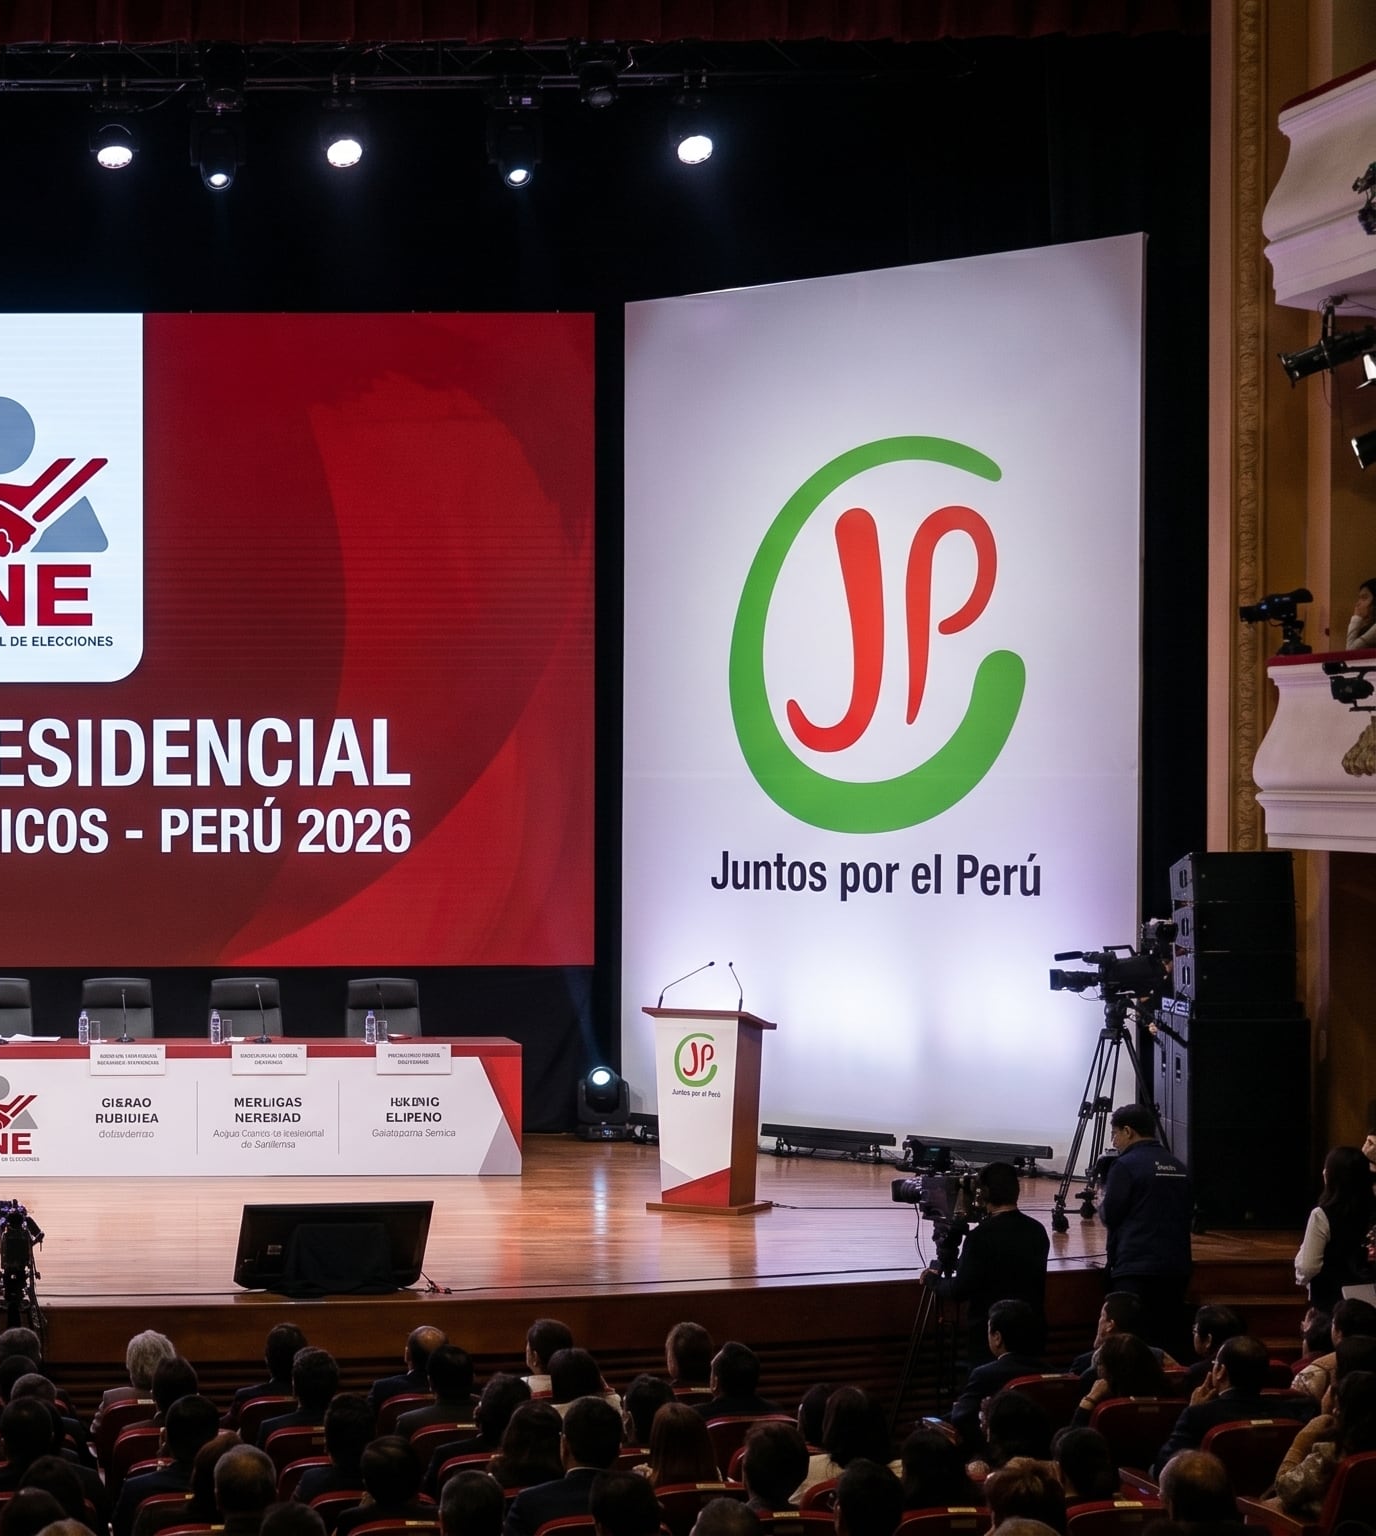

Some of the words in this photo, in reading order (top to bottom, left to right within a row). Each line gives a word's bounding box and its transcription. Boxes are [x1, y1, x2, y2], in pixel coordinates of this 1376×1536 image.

[10, 636, 28, 647] DE
[32, 636, 113, 647] ELECCIONES
[161, 798, 282, 856] PERÚ
[297, 807, 411, 855] 2026
[711, 850, 827, 892] Juntos
[840, 860, 900, 901] por
[911, 853, 942, 894] el
[956, 852, 1041, 896] Perú
[386, 1112, 442, 1123] ELIPENO
